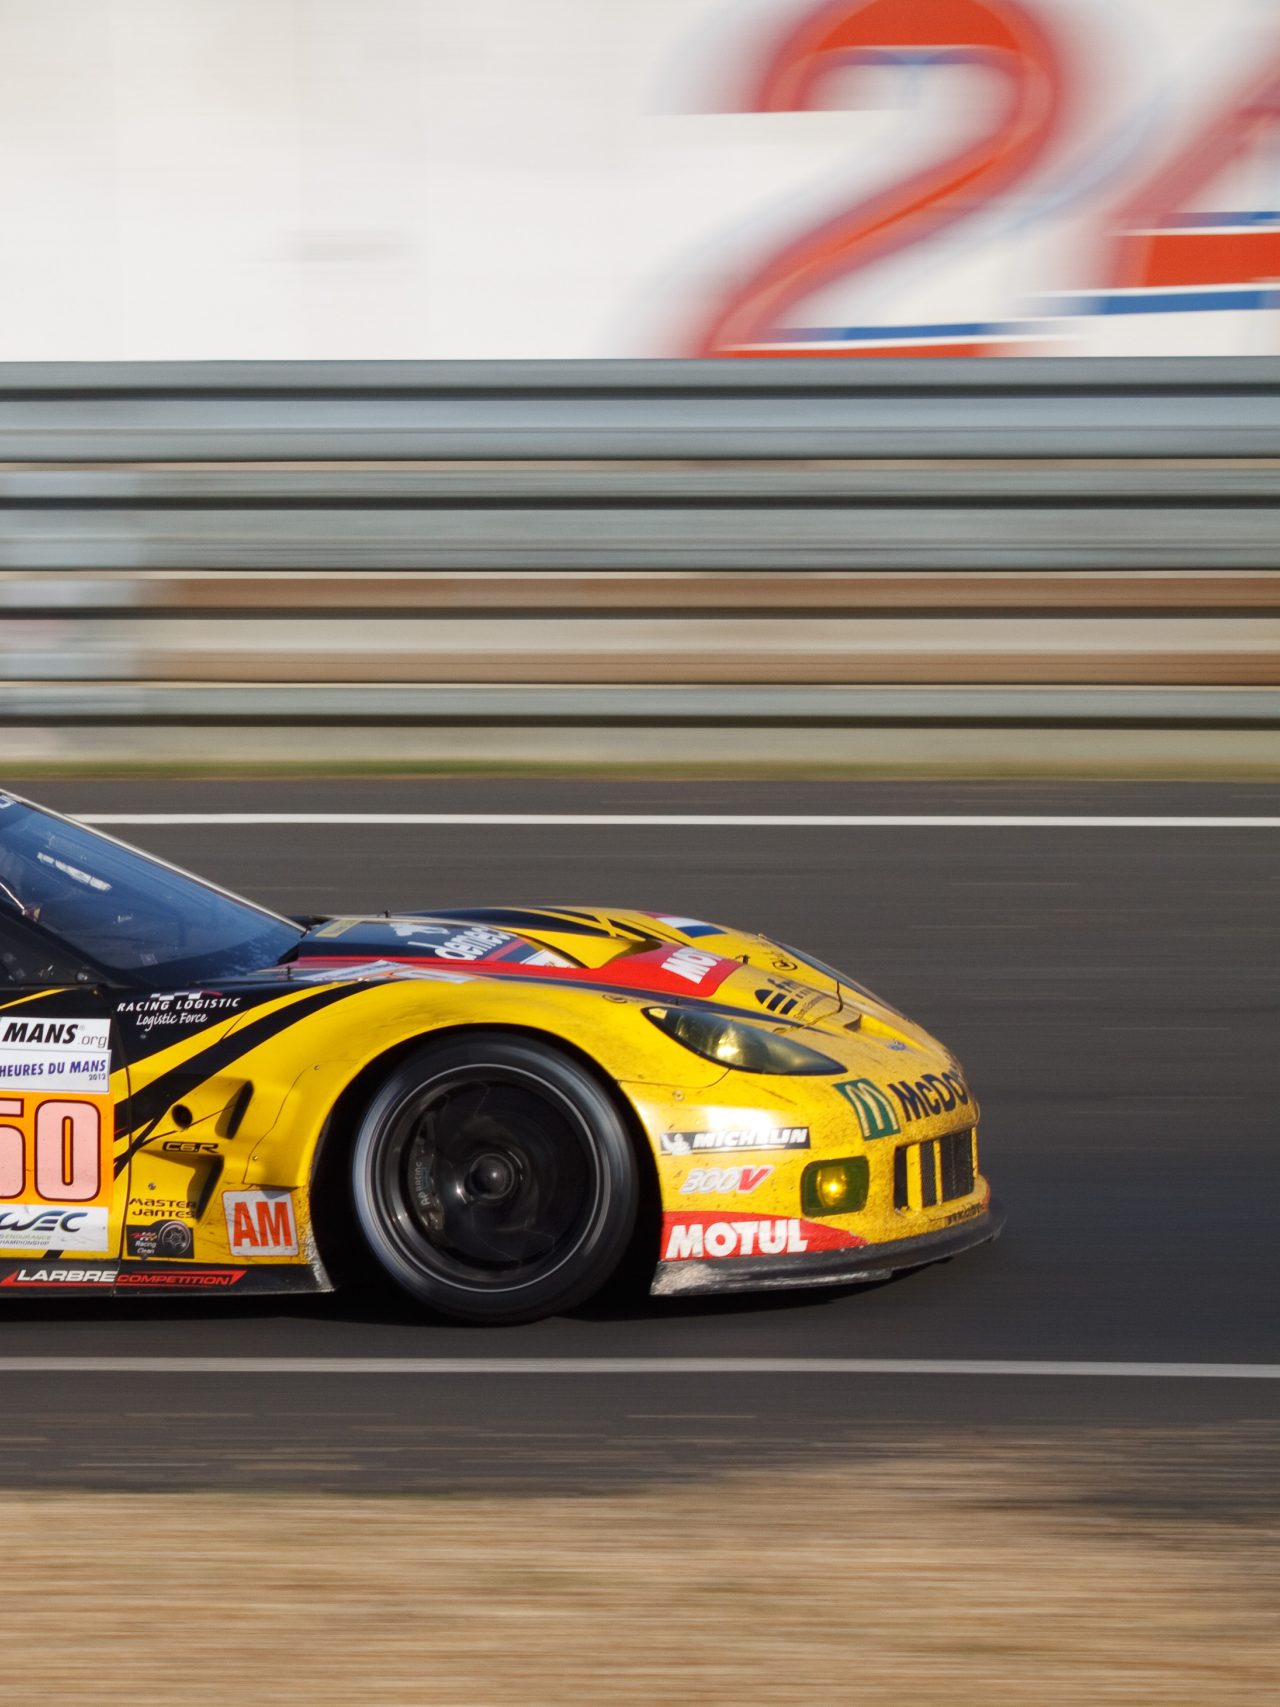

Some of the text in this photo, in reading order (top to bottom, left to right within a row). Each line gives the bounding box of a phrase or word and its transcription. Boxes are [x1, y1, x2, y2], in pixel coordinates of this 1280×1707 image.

[117, 997, 241, 1012] RACING LOGISTIC
[136, 1012, 208, 1032] Logistic Force
[2, 1023, 79, 1044] MANS
[48, 1062, 65, 1074] DU
[69, 1059, 106, 1073] MANS
[692, 1128, 808, 1148] MICHELIN
[679, 1164, 775, 1194] 300V
[233, 1201, 293, 1247] AM
[665, 1219, 808, 1259] MOTUL
[17, 1269, 230, 1286] LARBRE COMPETITION
